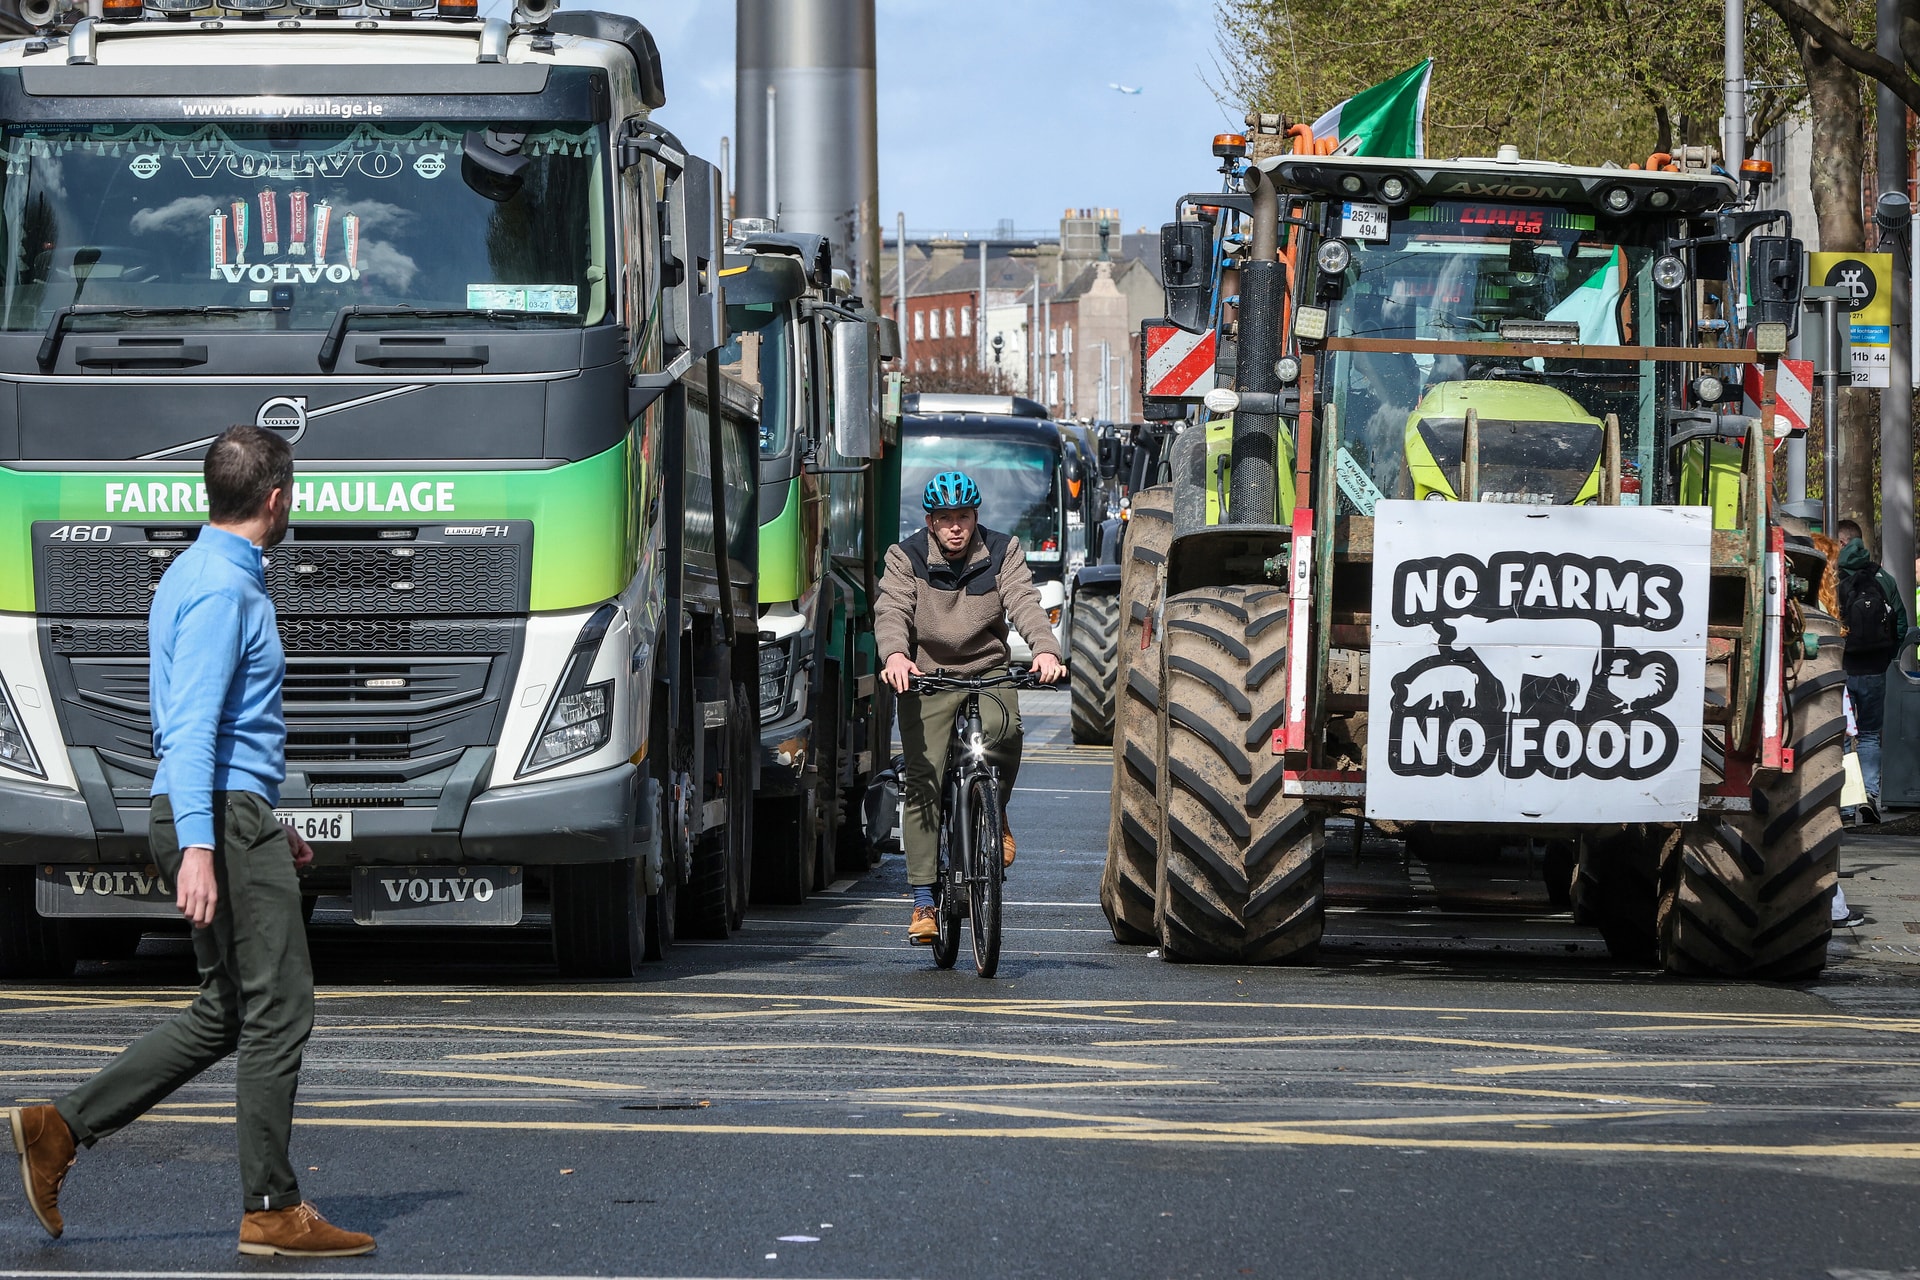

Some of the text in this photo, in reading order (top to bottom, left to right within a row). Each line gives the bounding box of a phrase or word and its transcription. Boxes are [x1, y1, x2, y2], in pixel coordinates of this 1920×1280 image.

[172, 151, 404, 178] VOLVO
[1443, 182, 1568, 199] AXION
[1351, 210, 1387, 224] 252-MH
[1460, 207, 1544, 226] CLAAS
[1359, 224, 1378, 237] 494
[1515, 225, 1541, 234] 830
[217, 264, 351, 283] VOLVO
[1851, 352, 1886, 362] 11b 44
[1851, 373, 1869, 381] 122
[105, 482, 455, 512] FARRE HAULAGE
[49, 525, 113, 542] 460
[481, 525, 510, 537] FH
[1404, 563, 1672, 620] NO FARMS
[1400, 716, 1667, 769] NO FOOD
[279, 817, 342, 839] -646
[380, 878, 494, 903] VOLVO
